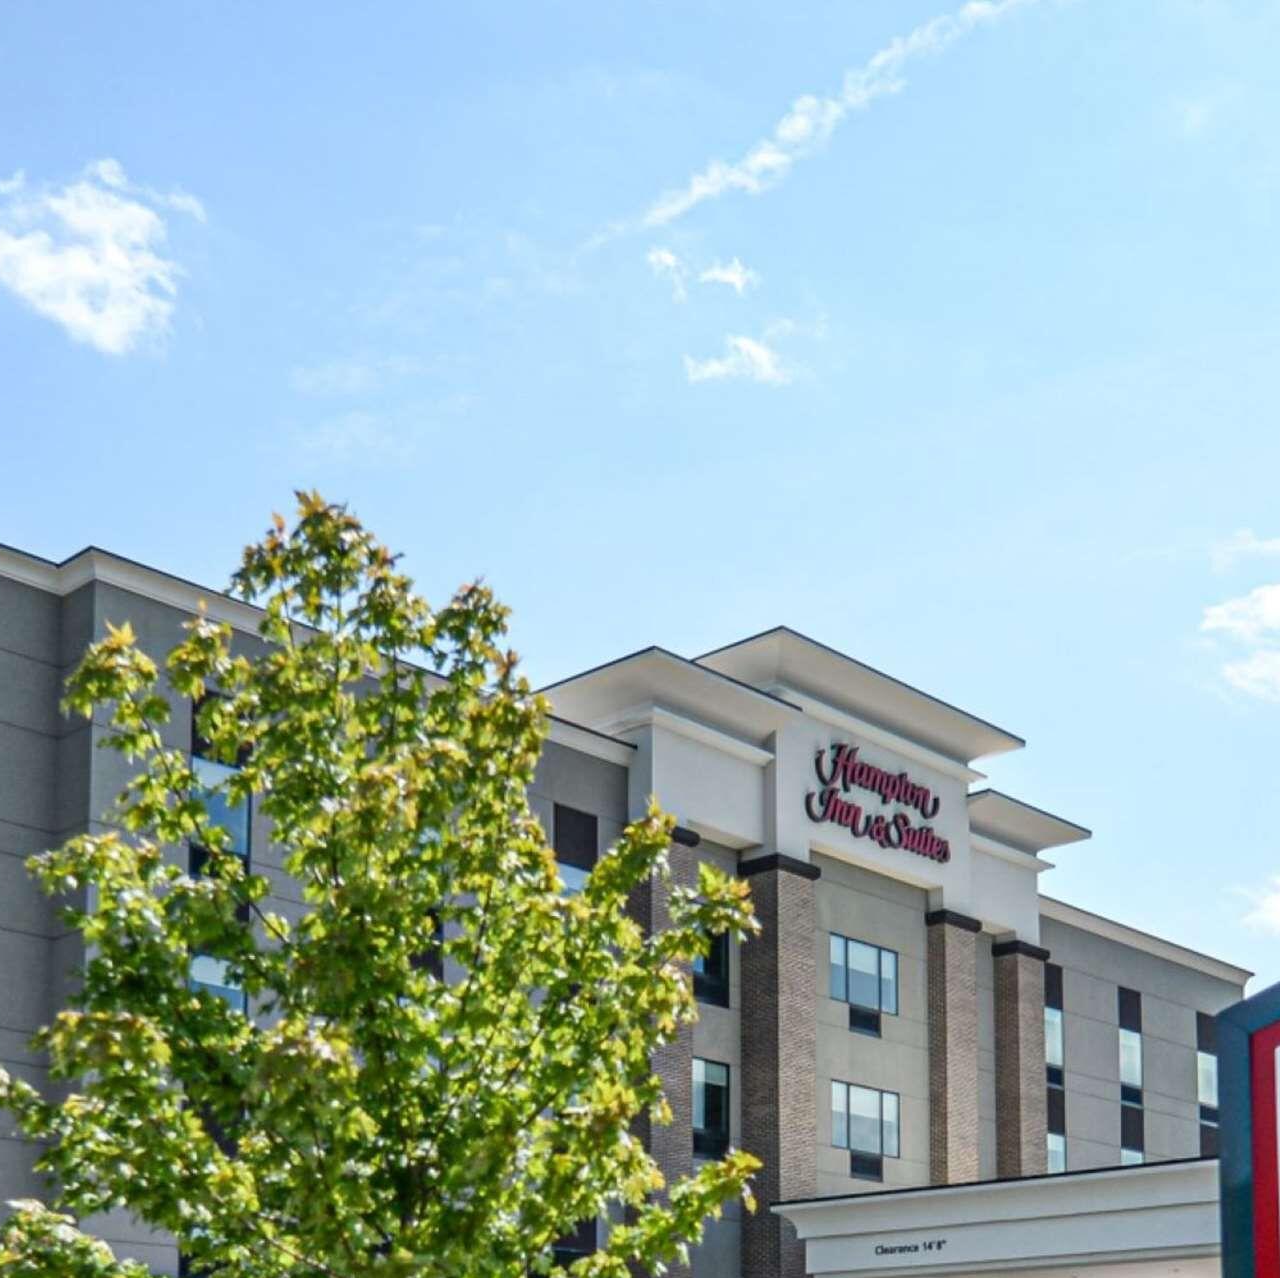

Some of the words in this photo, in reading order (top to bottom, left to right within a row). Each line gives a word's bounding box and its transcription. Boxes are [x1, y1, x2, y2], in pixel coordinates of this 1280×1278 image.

[815, 743, 939, 819] Hampton
[805, 788, 872, 837] Inn
[886, 813, 950, 863] Suites
[875, 1244, 919, 1255] Clearance
